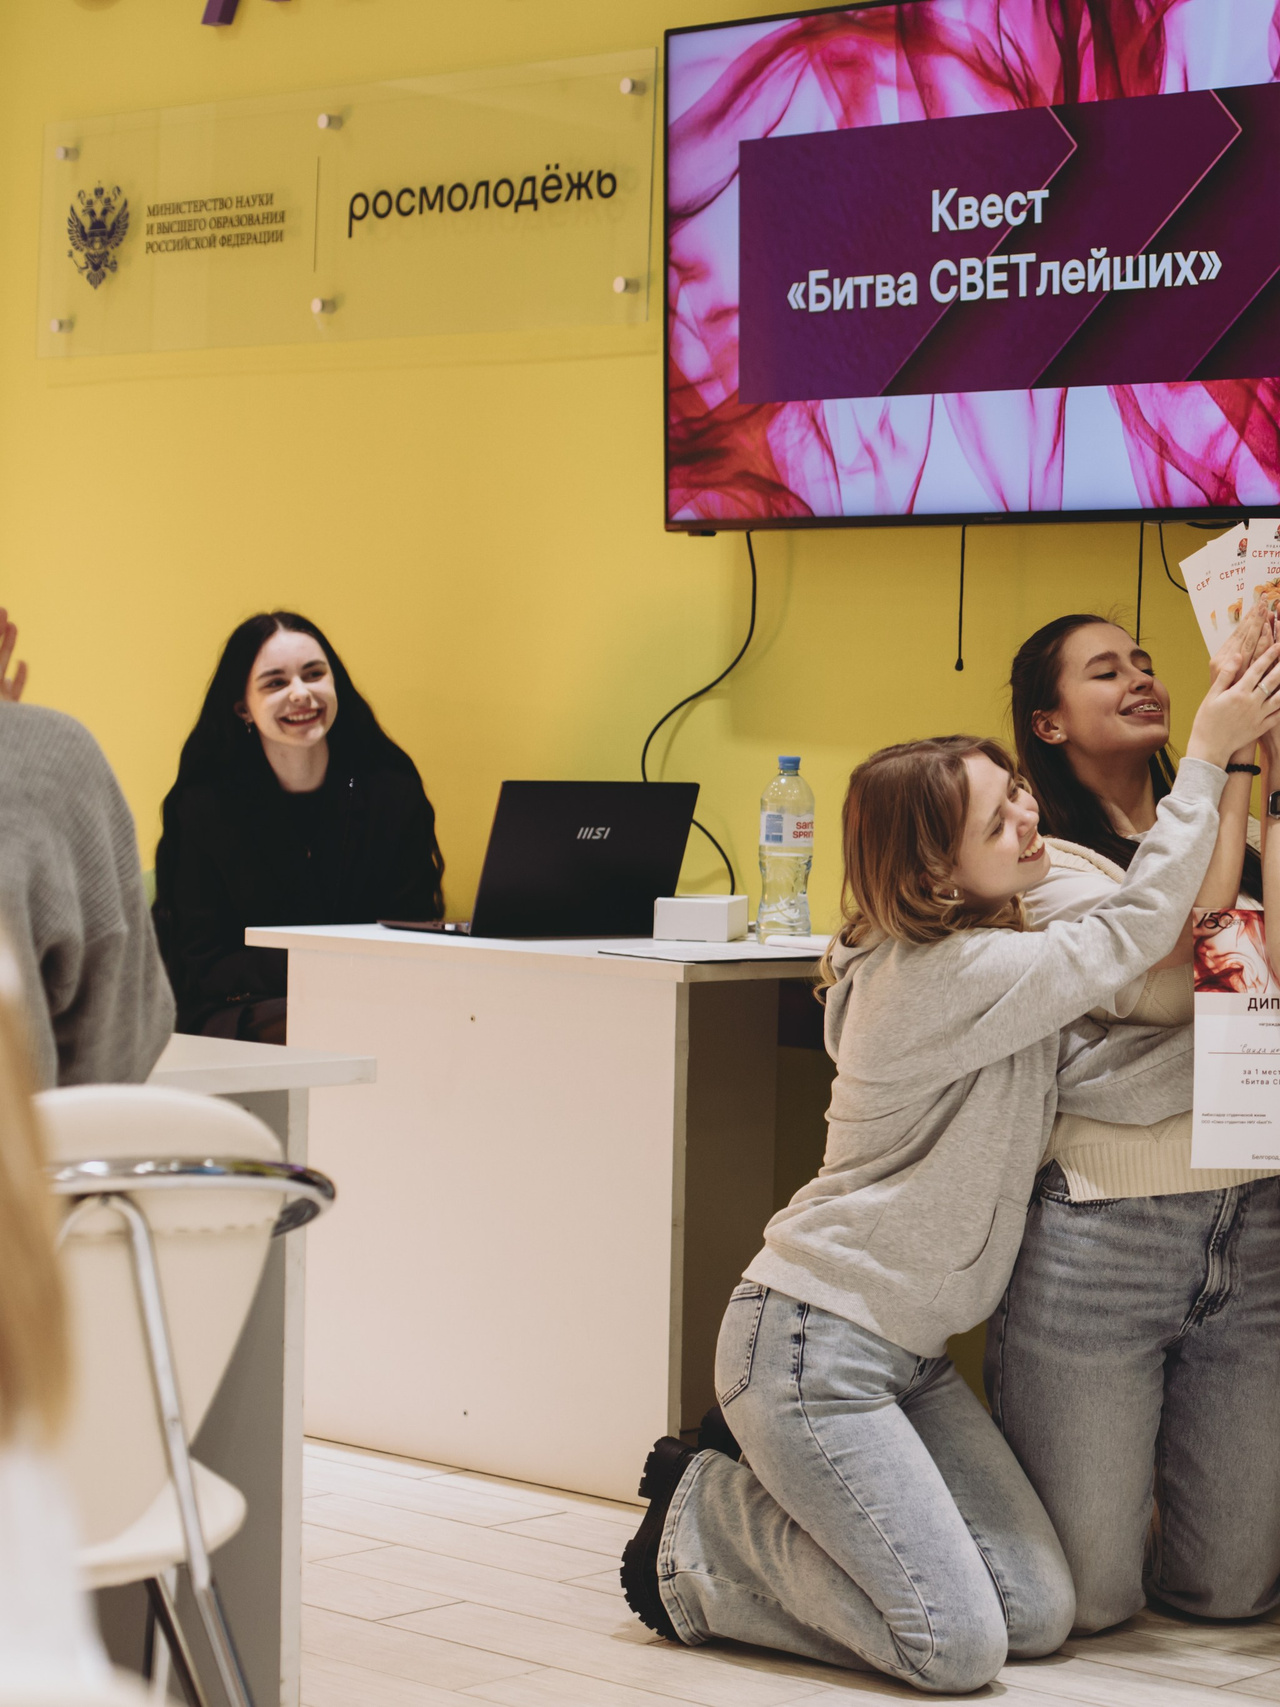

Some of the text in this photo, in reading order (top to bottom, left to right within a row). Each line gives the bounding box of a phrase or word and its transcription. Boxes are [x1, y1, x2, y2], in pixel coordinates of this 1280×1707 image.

[146, 192, 274, 217] МИНИСТЕРСТВО НАУКИ
[348, 163, 617, 238] росмолодёжь
[931, 187, 1049, 232] Квест
[146, 210, 286, 235] И ВЫСШЕГО ОБРАЗОВАНИЯ
[145, 229, 284, 254] РОССИЙСКОЙ ФЕДЕРАЦИИ
[786, 248, 1222, 313] «Битва СВЕТлейших»
[576, 826, 611, 840] MSI
[1251, 1153, 1280, 1161] Белгород,
